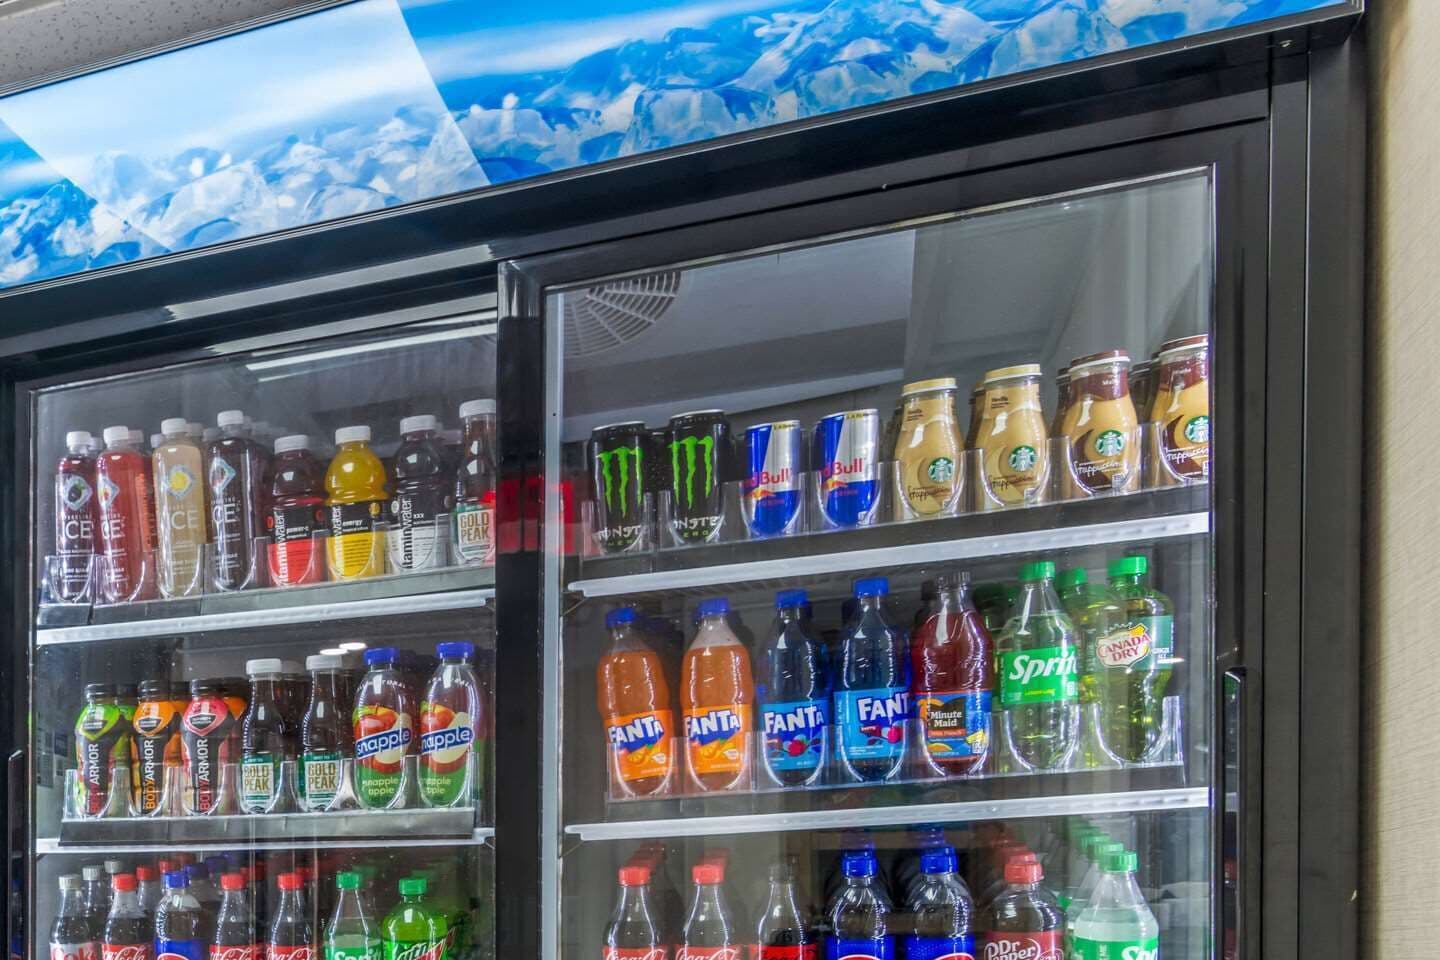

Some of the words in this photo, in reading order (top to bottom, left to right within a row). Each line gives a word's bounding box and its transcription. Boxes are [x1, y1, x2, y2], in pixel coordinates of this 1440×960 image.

[832, 458, 863, 475] Bull
[760, 469, 789, 485] Bull
[460, 512, 489, 528] GOLD
[673, 516, 721, 529] ONSTE
[401, 499, 413, 569] itaminwater
[461, 527, 489, 543] PEAK
[1098, 633, 1150, 657] CANADA
[1112, 647, 1138, 661] DRY
[1009, 651, 1077, 685] Sprit
[858, 693, 910, 720] FANT
[764, 706, 824, 734] FANTA
[930, 711, 962, 719] Minute
[934, 719, 958, 727] Maid
[608, 716, 664, 744] FANTA
[685, 711, 741, 737] FANTA
[422, 727, 471, 751] napple
[245, 765, 269, 777] GOLD
[308, 762, 336, 776] GOLD
[245, 777, 269, 791] PEAK
[309, 776, 336, 789] PEAK
[368, 786, 395, 796] apple
[999, 940, 1020, 953] Dr
